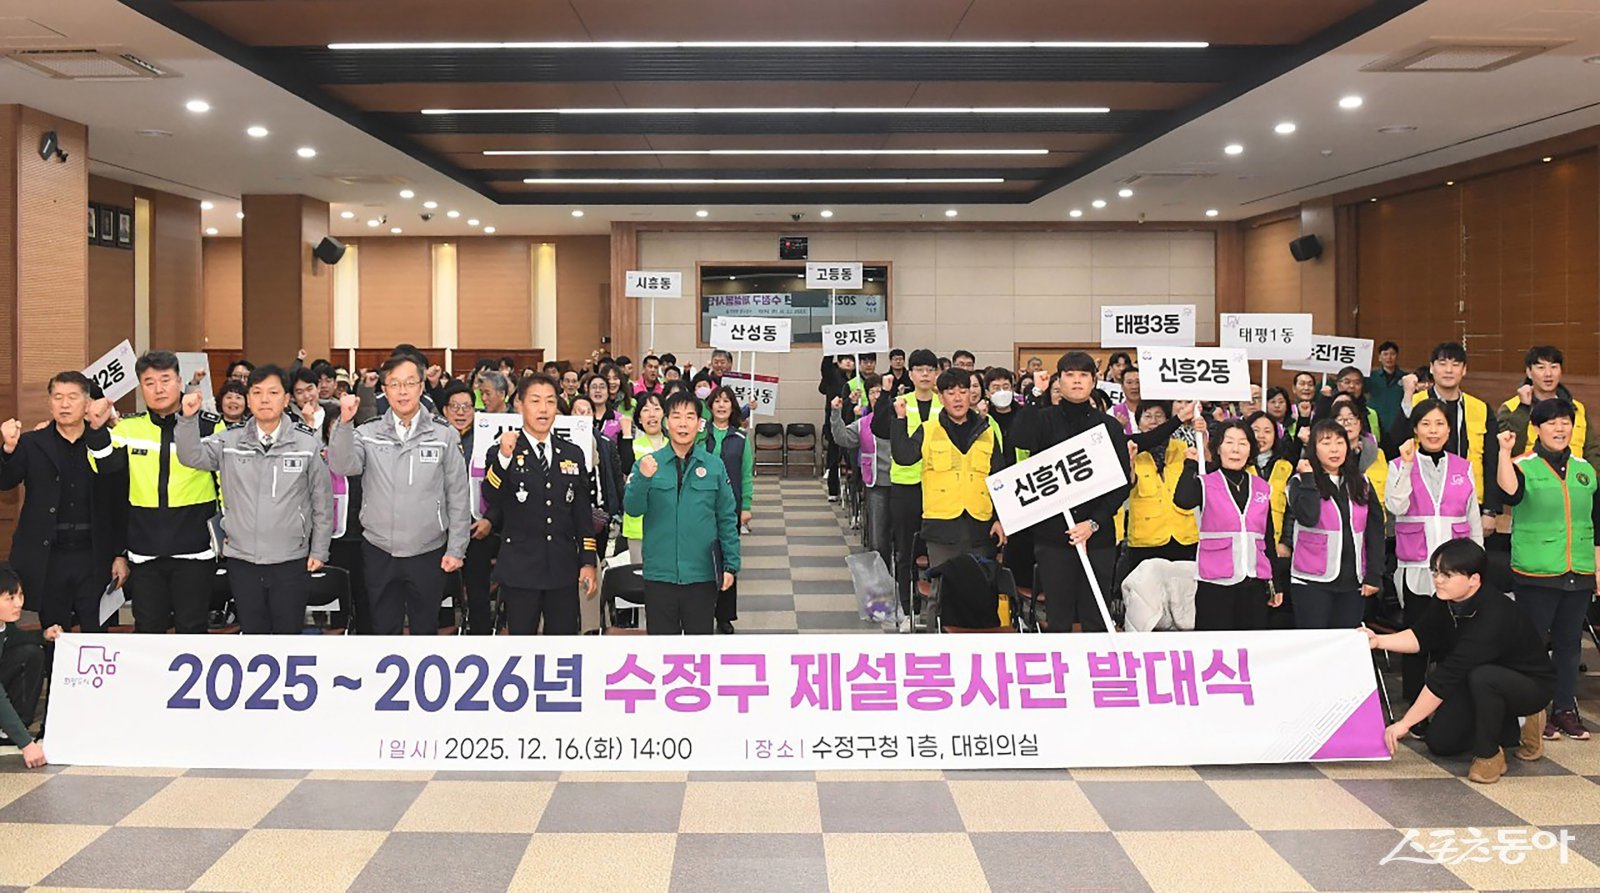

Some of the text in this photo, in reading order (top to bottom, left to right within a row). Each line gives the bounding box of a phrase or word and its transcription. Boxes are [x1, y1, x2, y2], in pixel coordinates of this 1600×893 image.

[636, 276, 671, 290] 시흥동
[816, 267, 852, 281] 고등동
[730, 324, 777, 342] 산성동
[1115, 314, 1181, 335] 태평3동
[834, 328, 877, 345] 양지동
[1239, 327, 1294, 343] 태평1동
[1311, 344, 1356, 364] 진1동
[1158, 357, 1231, 384] 신흥2동
[1014, 448, 1094, 507] 신흥1동
[375, 653, 583, 713] 2026년
[605, 652, 770, 714] 수정구
[791, 650, 1069, 712] 제설봉사단
[1087, 648, 1255, 708] 발대식
[444, 737, 509, 760] 2025.
[517, 737, 547, 760] 12.
[630, 737, 693, 760] 14:00
[811, 735, 899, 760] 수정구청
[906, 734, 944, 761] 1층,
[951, 733, 1039, 758] 대회의실
